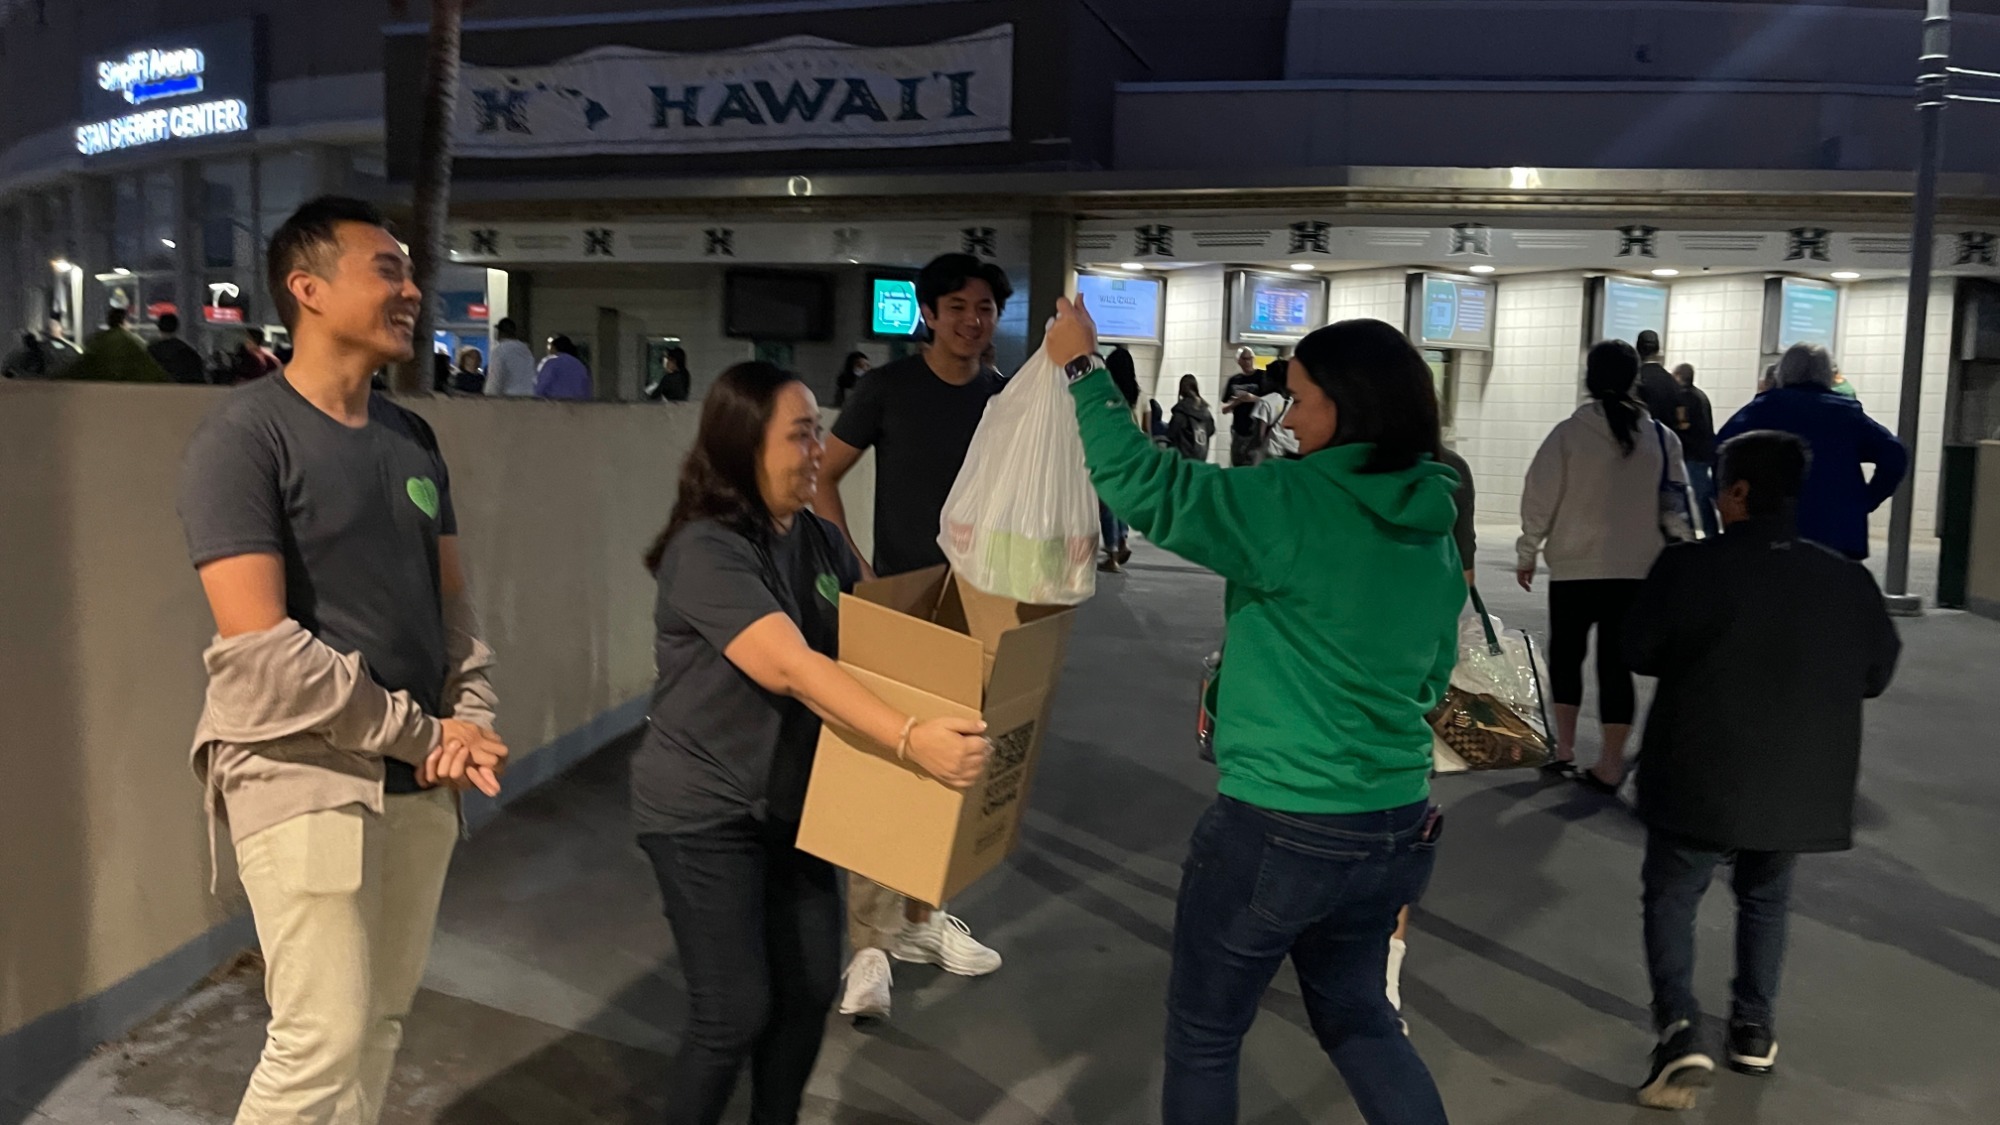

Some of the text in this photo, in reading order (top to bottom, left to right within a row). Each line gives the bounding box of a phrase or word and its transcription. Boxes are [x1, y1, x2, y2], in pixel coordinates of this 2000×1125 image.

[150, 48, 204, 80] Arena
[110, 109, 169, 149] SHERIFF
[169, 99, 248, 138] CENTER
